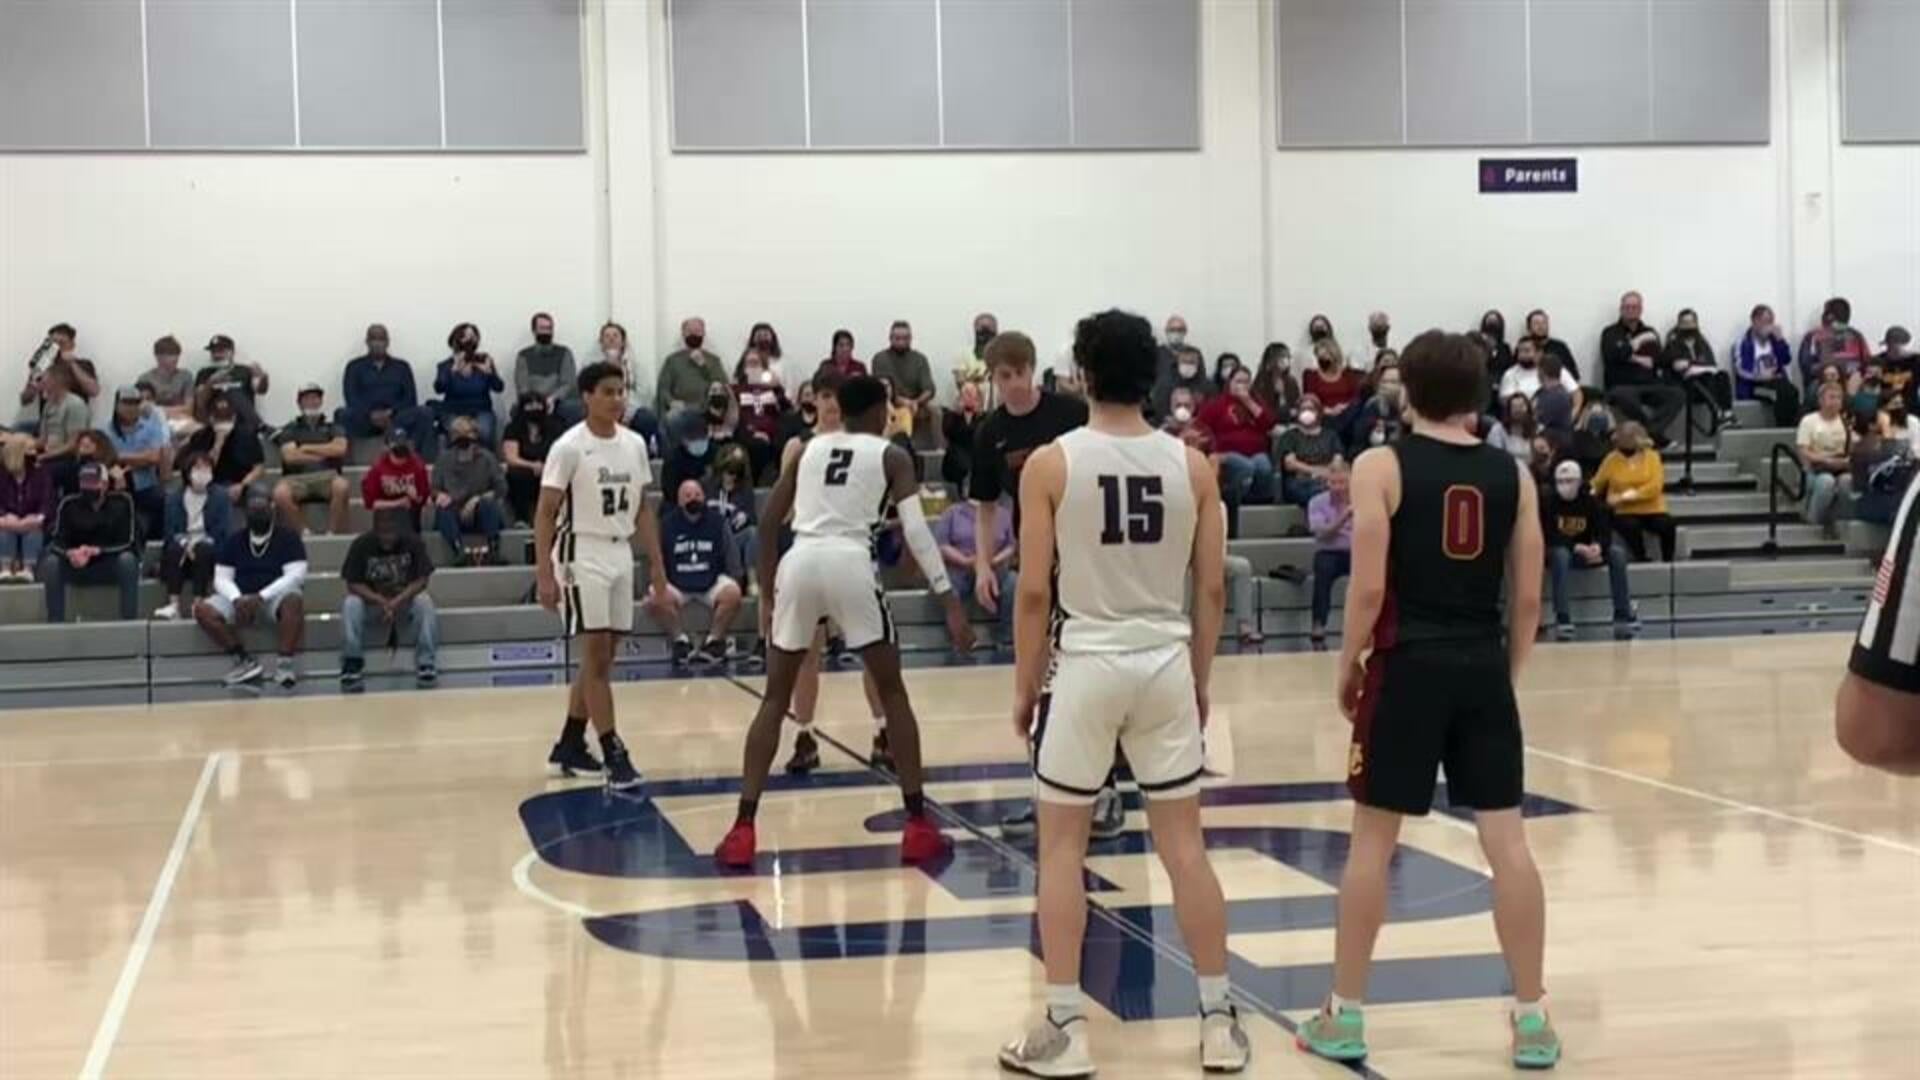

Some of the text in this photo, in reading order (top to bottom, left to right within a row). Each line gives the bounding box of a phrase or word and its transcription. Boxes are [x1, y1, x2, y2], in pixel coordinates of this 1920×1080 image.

[1505, 167, 1567, 183] Parents
[825, 448, 854, 486] 2
[1098, 475, 1165, 545] 15
[1442, 484, 1484, 560] 0
